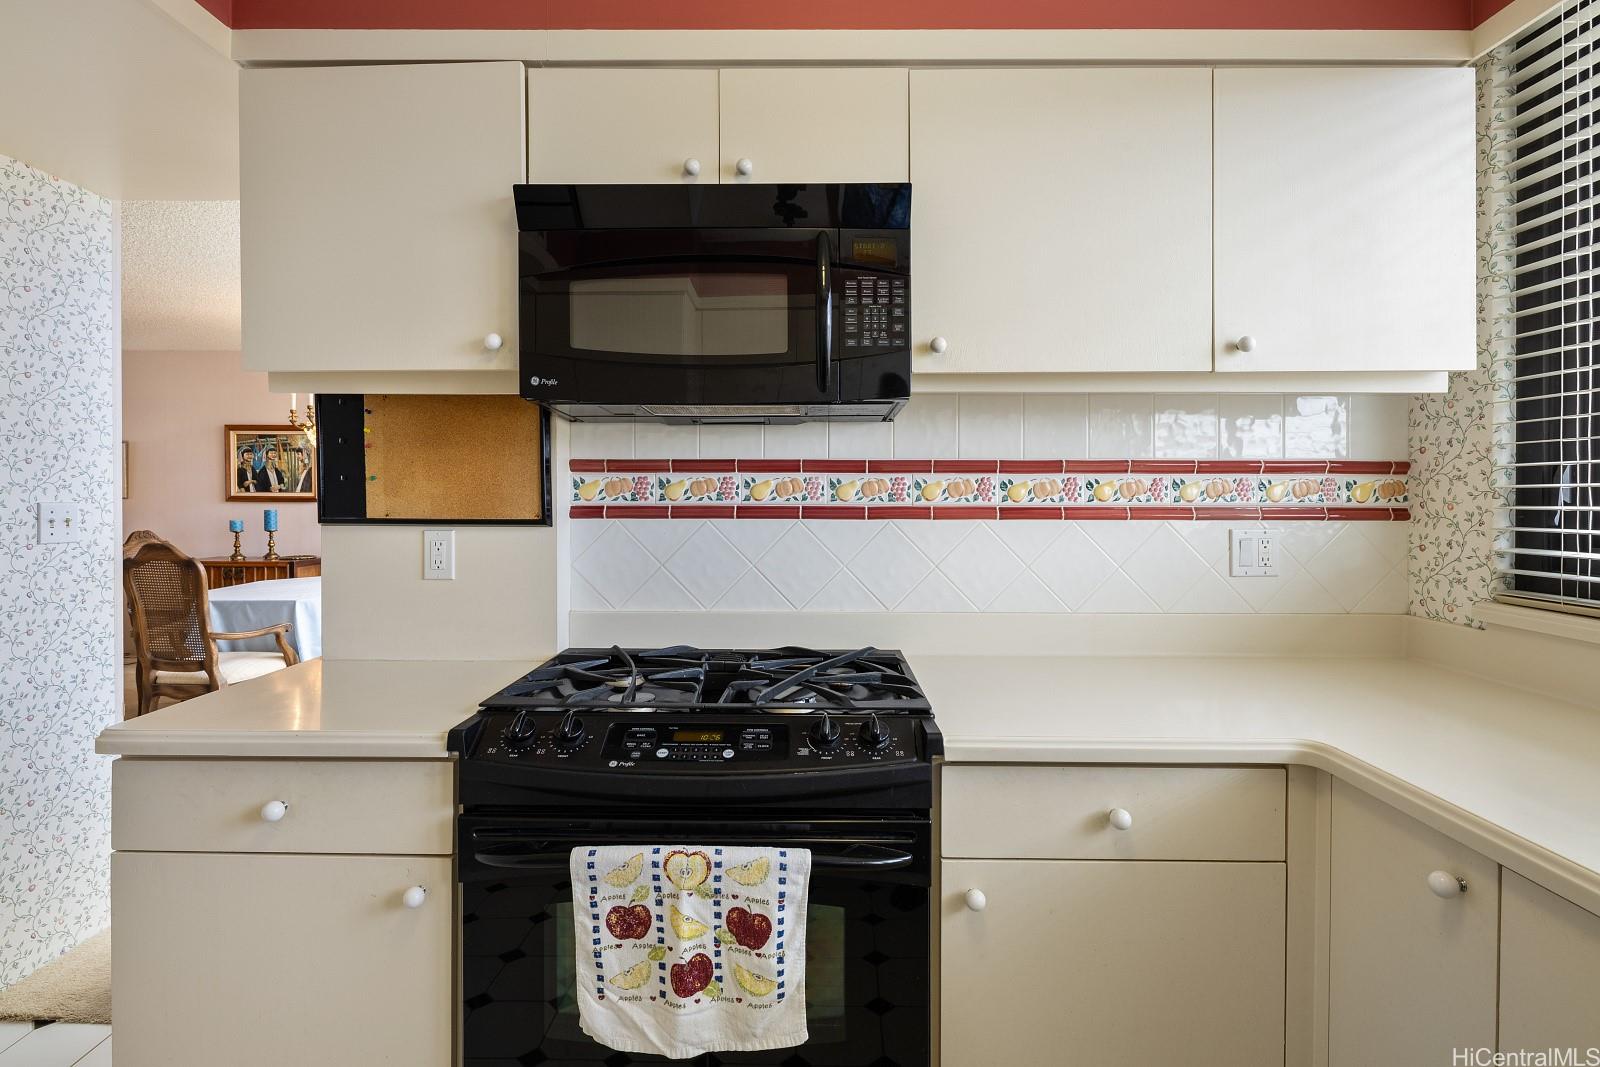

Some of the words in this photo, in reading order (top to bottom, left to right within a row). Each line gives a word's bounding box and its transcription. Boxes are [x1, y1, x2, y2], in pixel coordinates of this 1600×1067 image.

[540, 378, 558, 386] Profile
[600, 893, 627, 903] Apples
[743, 896, 770, 906] Apples
[681, 943, 707, 955] Apples
[747, 1002, 773, 1010] Apples
